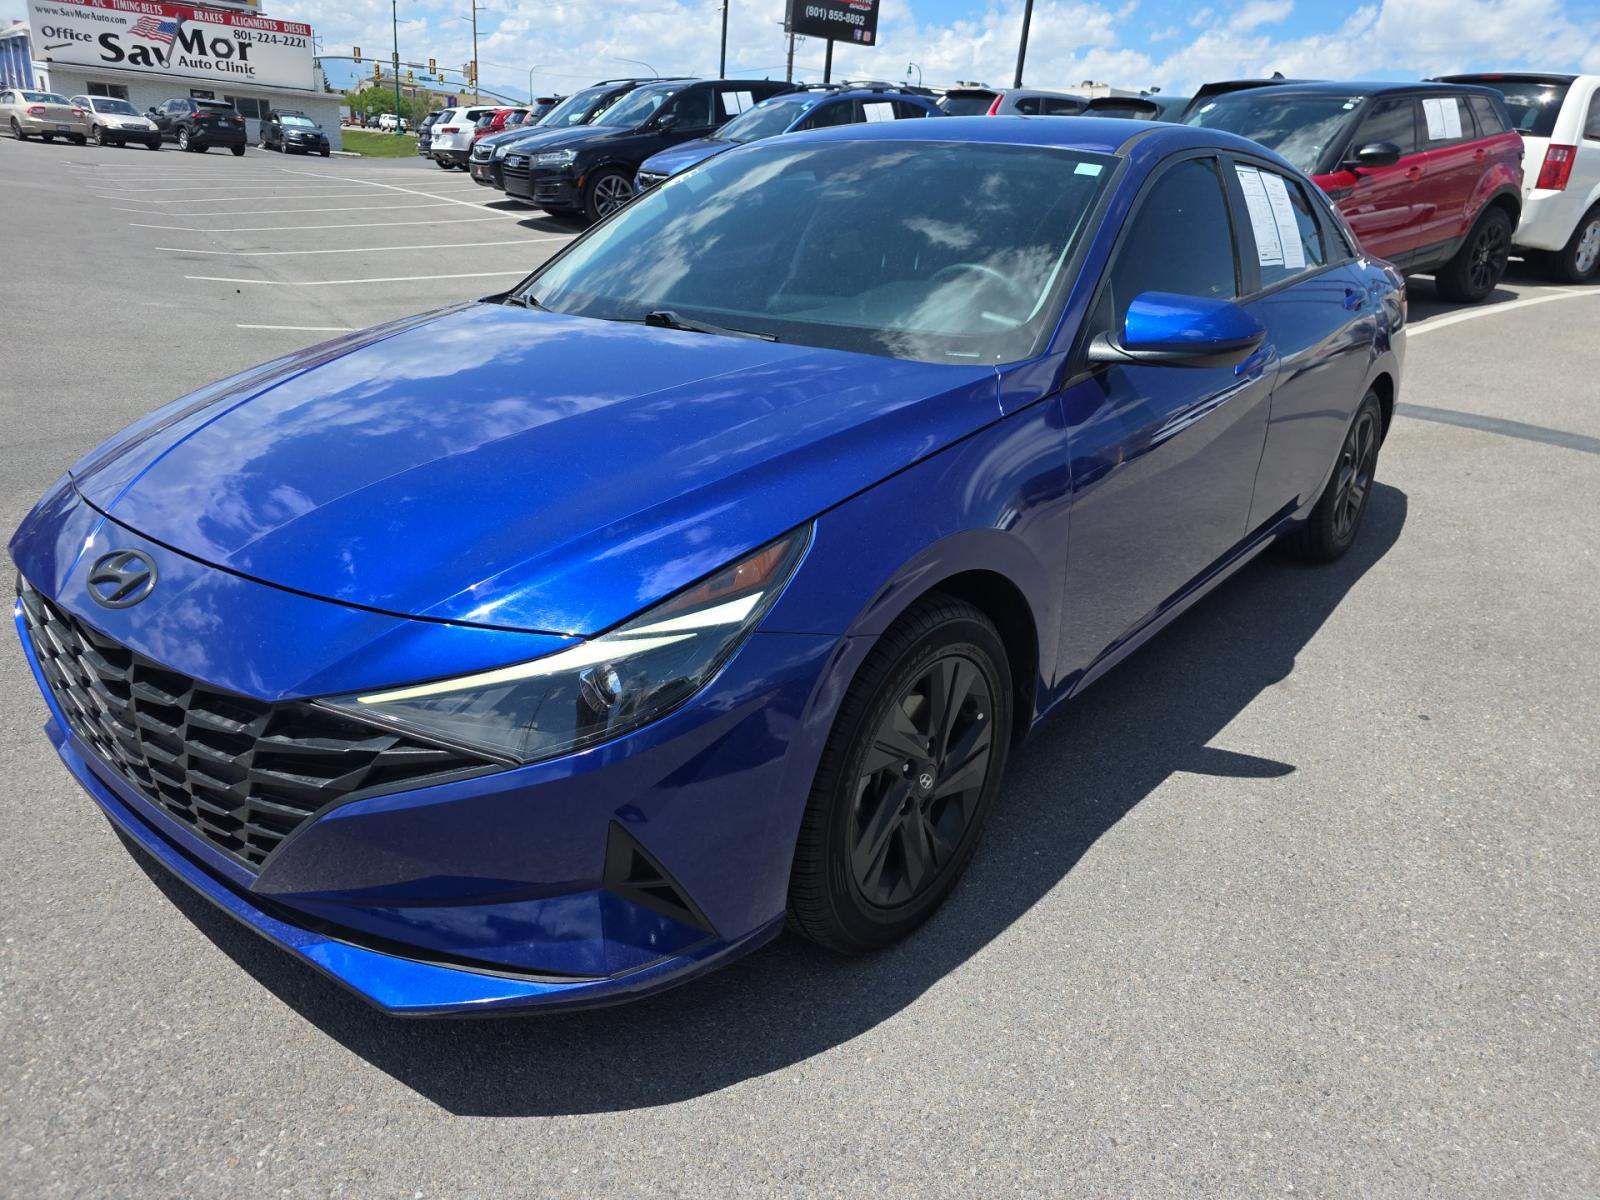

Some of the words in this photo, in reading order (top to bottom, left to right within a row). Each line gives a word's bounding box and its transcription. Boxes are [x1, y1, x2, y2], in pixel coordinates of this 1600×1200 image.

[35, 6, 127, 24] www.SavMorAuto.com
[113, 0, 140, 11] TIMING
[141, 4, 163, 15] BELTS
[193, 10, 224, 24] BRAKES
[230, 15, 278, 31] ALIGNMENTS
[283, 22, 308, 35] DIESEL
[805, 6, 827, 20] (801)
[41, 25, 93, 42] Office
[233, 29, 307, 49] 801-224-2221
[178, 55, 213, 70] Auto
[215, 60, 255, 74] Clinic
